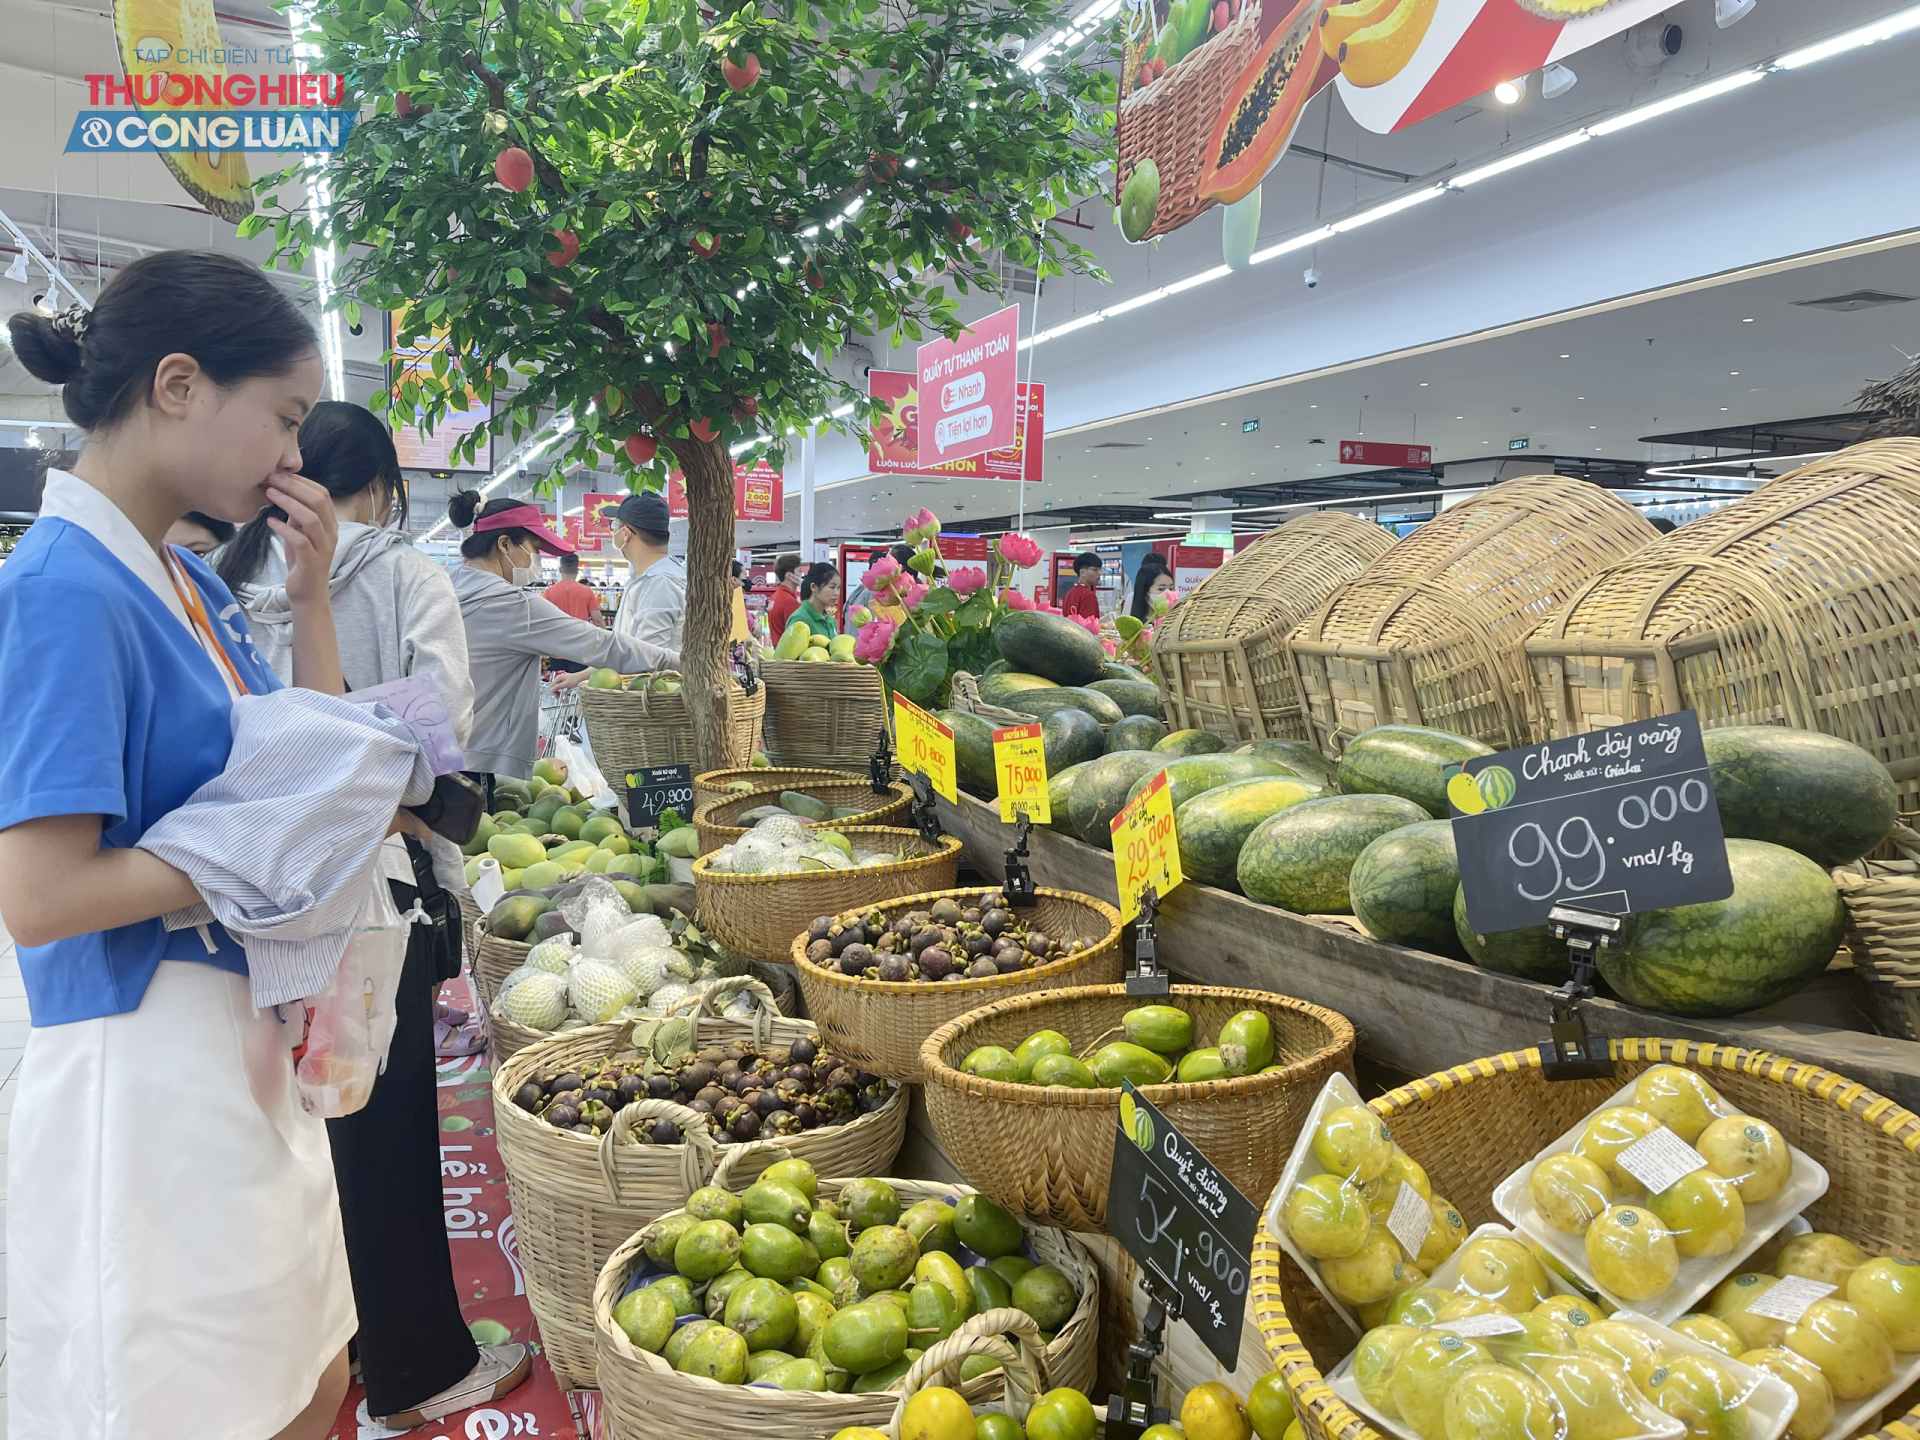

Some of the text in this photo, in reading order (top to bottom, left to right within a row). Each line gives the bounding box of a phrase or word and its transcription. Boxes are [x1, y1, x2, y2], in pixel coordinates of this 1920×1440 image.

[955, 345, 983, 370] THANH
[985, 333, 1010, 358] TOÁN
[958, 379, 982, 401] Nhanh
[947, 414, 987, 439] Tiện lợi hơn
[876, 459, 899, 468] LUÔN
[900, 460, 918, 469] LUÔ
[945, 459, 977, 472] HƠN
[1522, 723, 1682, 781] Chanh dây vàng
[1564, 769, 1586, 782] Xuất
[438, 1145, 488, 1177] Lễ
[1164, 1132, 1228, 1214] Quýt đường
